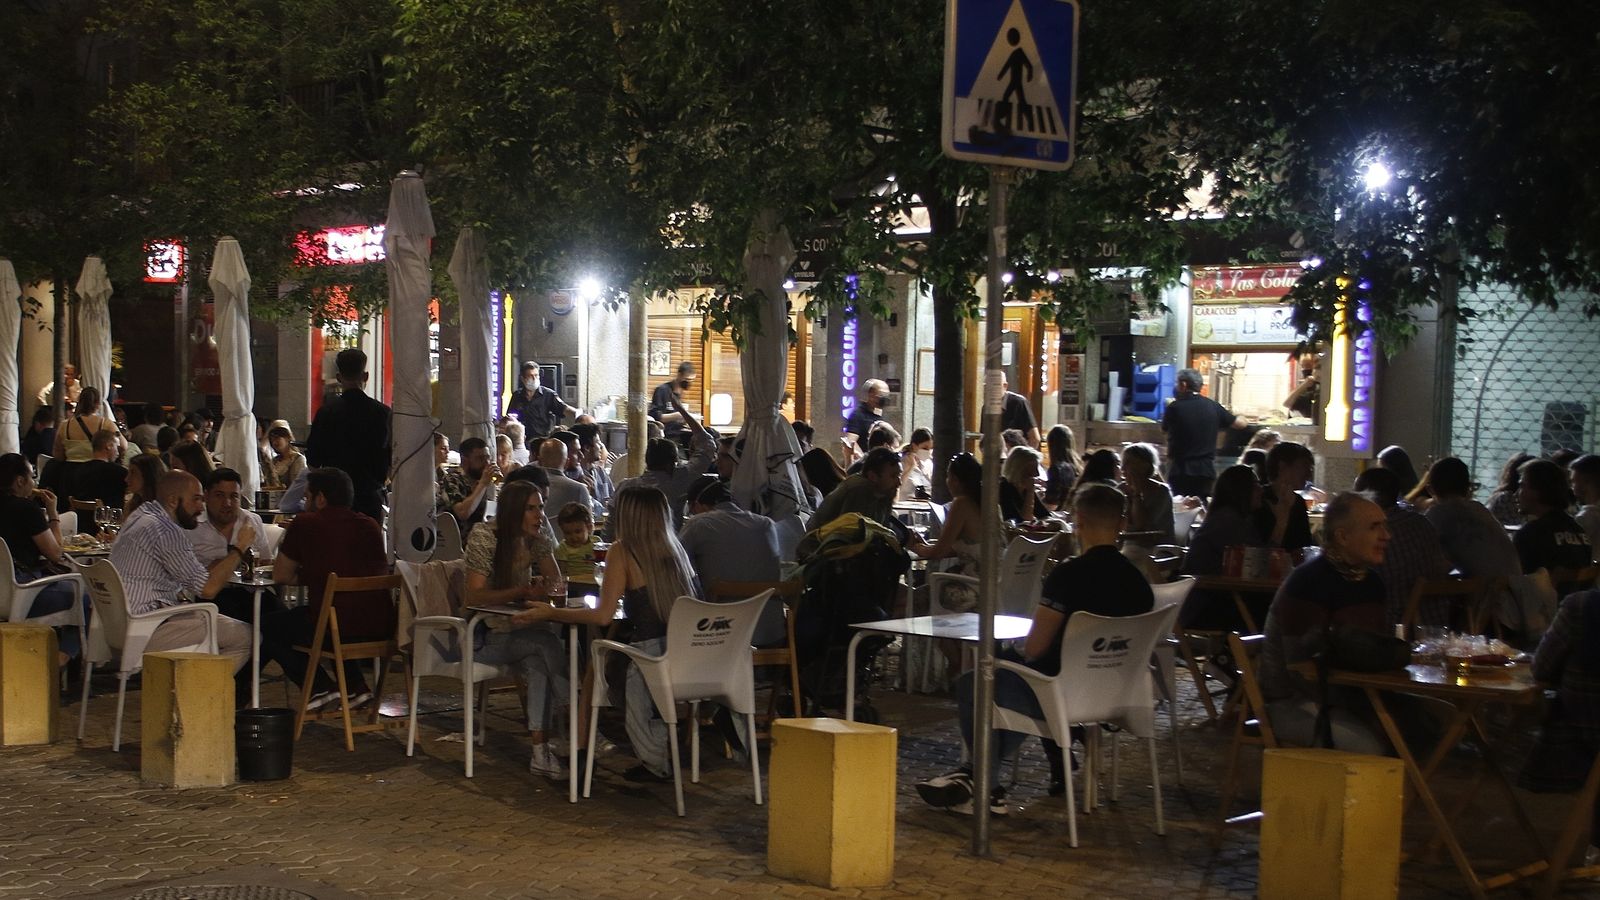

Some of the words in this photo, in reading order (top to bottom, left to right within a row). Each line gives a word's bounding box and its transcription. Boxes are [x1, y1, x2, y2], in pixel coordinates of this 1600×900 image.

[1227, 270, 1256, 293] Las
[1259, 268, 1299, 288] Colu
[1195, 306, 1237, 317] CARACOLES
[1352, 407, 1370, 450] BAR
